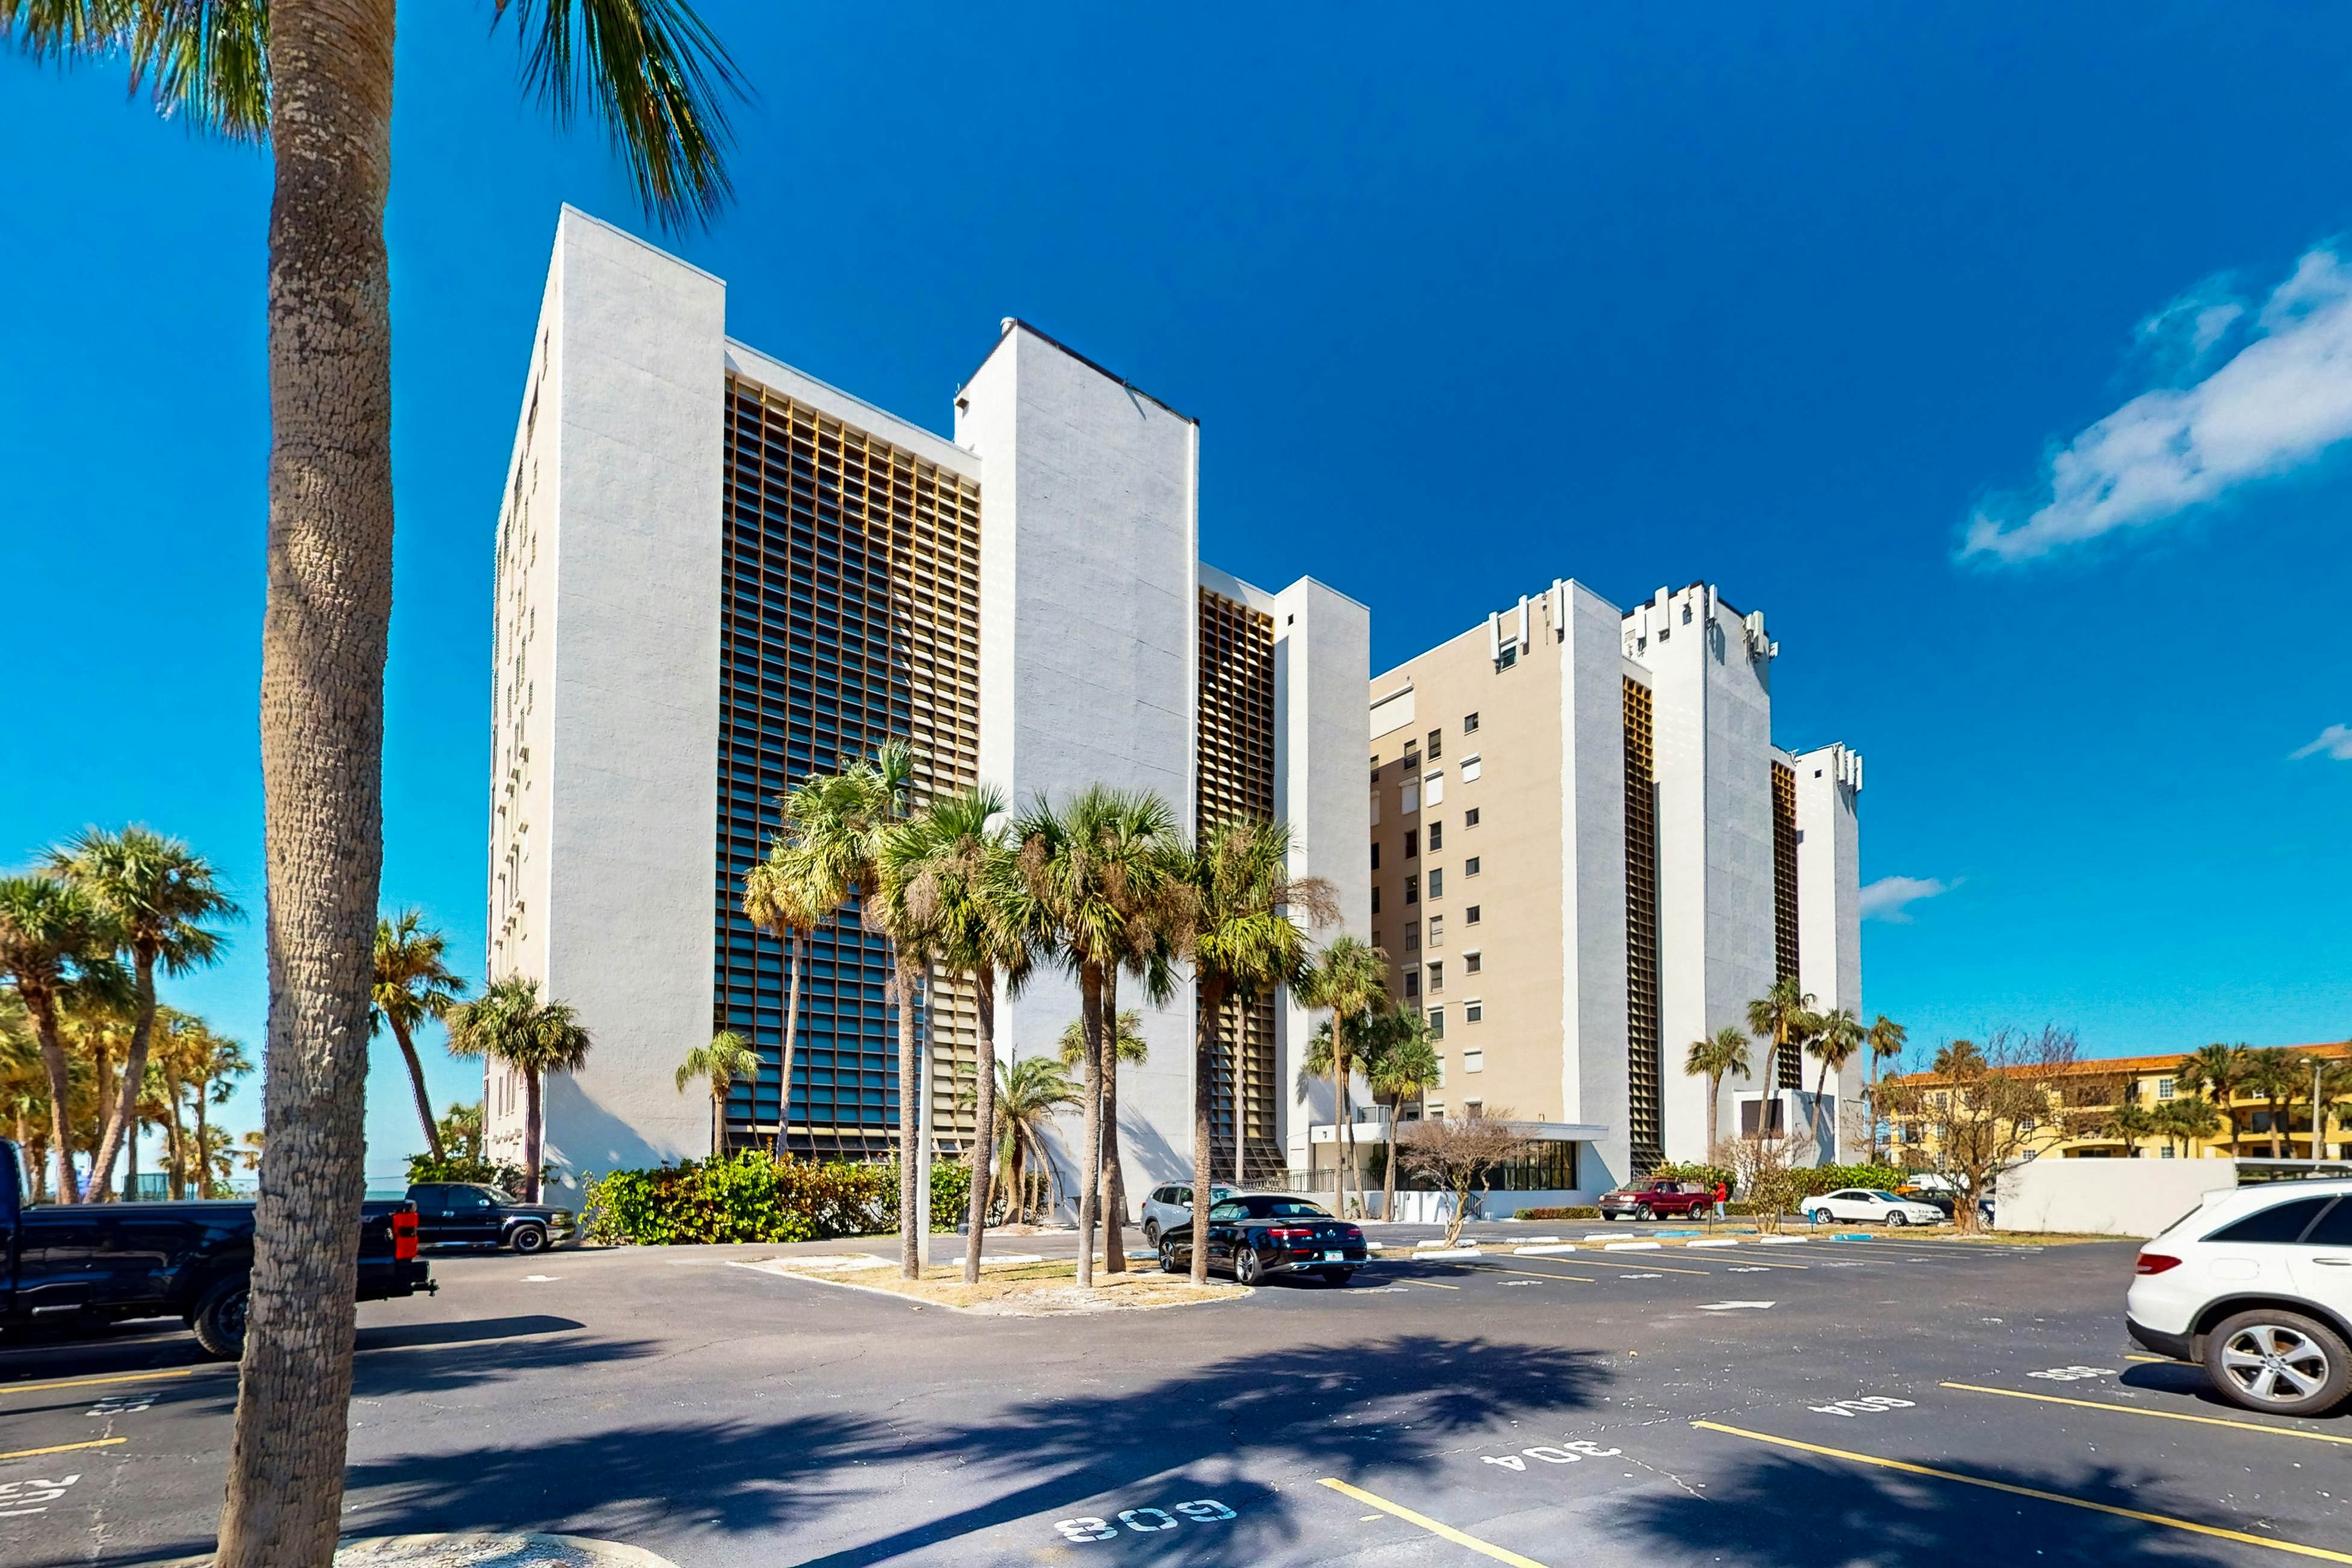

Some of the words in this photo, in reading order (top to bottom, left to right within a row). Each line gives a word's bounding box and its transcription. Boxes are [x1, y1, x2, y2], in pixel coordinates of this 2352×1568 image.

[1806, 1396, 1916, 1417] 604
[1479, 1440, 1622, 1471] 304
[1054, 1499, 1237, 1543] 608
